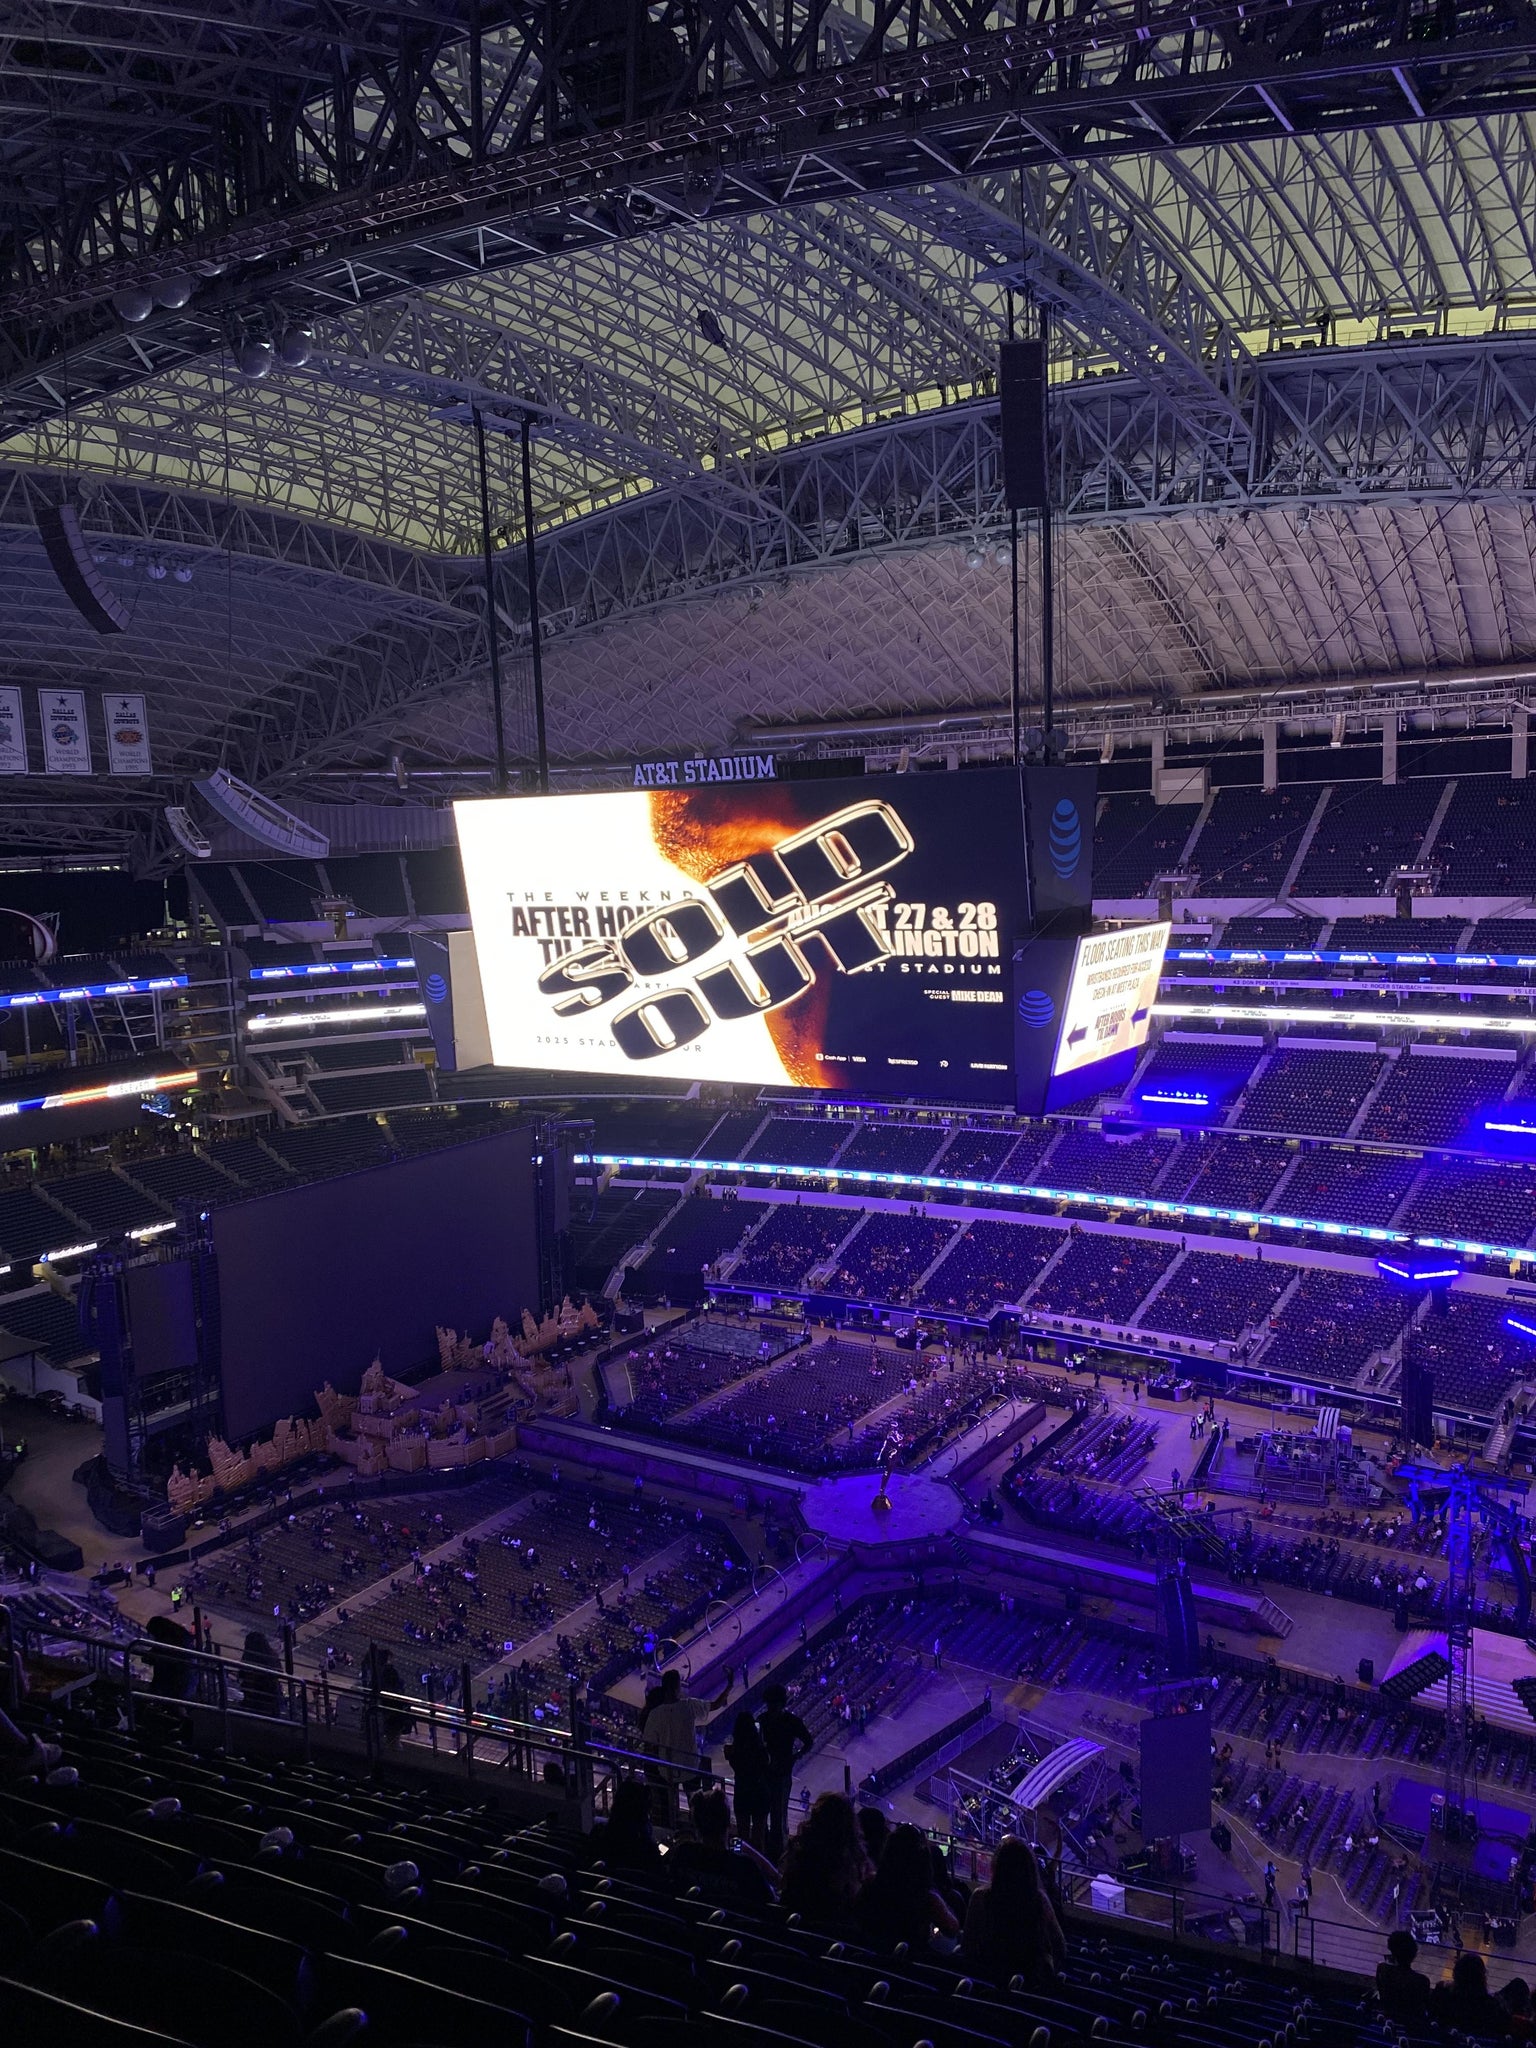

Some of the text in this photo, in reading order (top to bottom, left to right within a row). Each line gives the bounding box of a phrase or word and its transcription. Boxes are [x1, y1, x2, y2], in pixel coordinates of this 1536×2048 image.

[633, 754, 776, 786] AT&T STADIUM
[506, 890, 694, 902] THE WEEKND
[538, 798, 915, 1018] SOLD
[512, 906, 591, 937] AFTER
[894, 903, 926, 930] 27
[931, 906, 954, 930] &
[957, 902, 997, 930] 28
[880, 930, 999, 957] LINGTON
[1081, 928, 1166, 968] FLOOR SEATING THIS WAY
[1178, 951, 1206, 959] American
[1230, 952, 1258, 960] American
[1396, 955, 1427, 963] American
[1455, 956, 1487, 964] American
[901, 963, 1002, 974] STADIUM
[951, 990, 1003, 1002] MIKE DEAN
[537, 1036, 569, 1044] 2025
[579, 1038, 617, 1047] STAD
